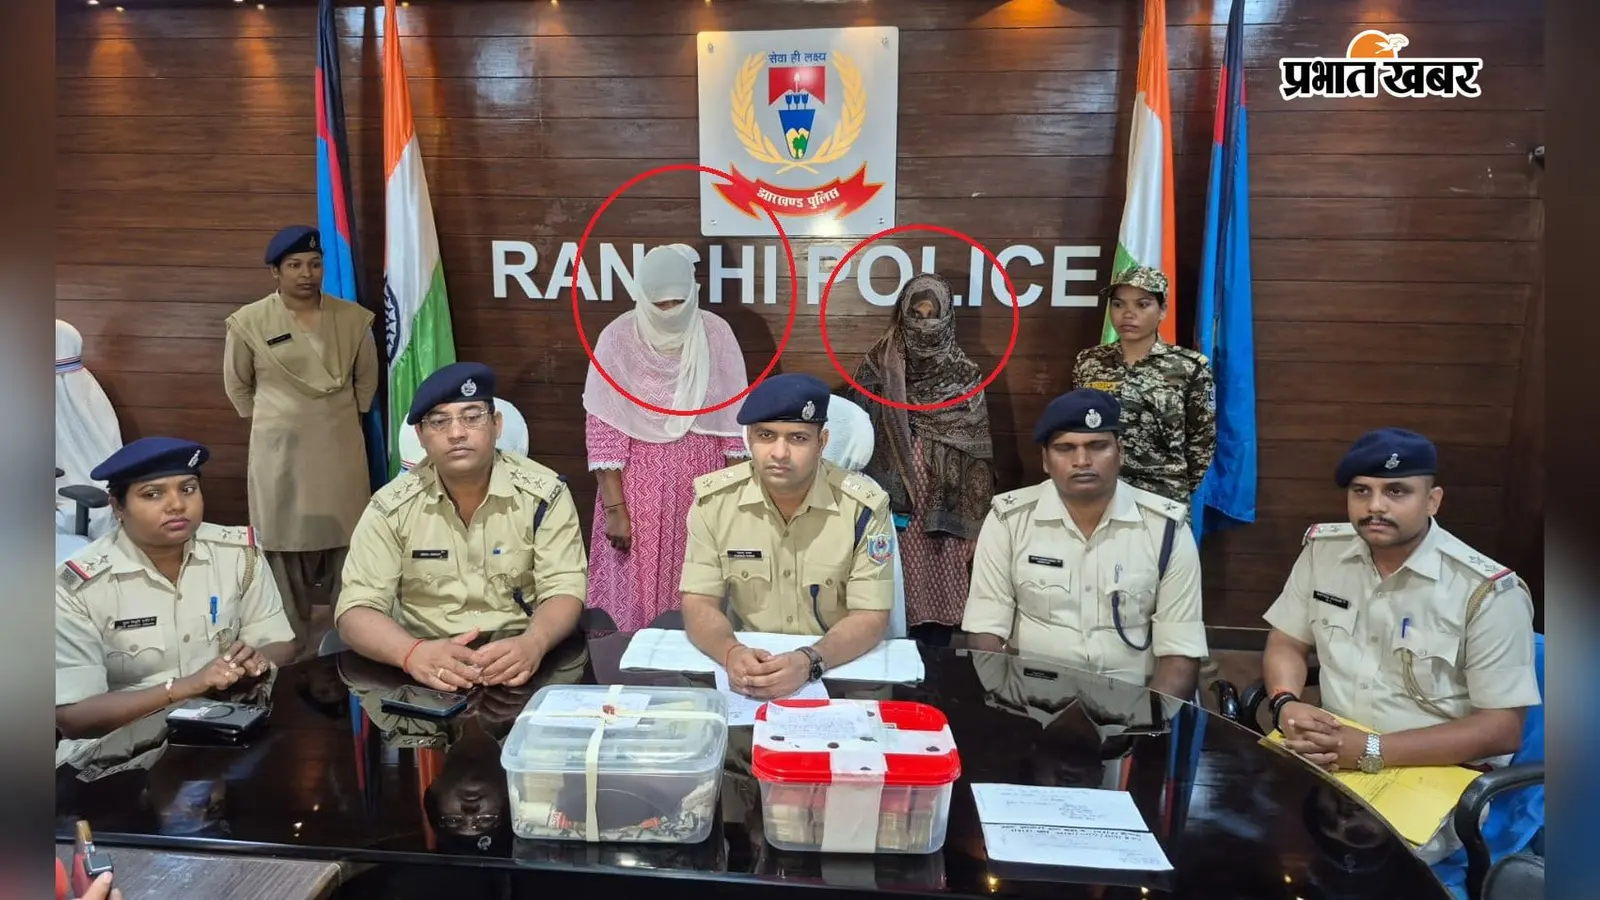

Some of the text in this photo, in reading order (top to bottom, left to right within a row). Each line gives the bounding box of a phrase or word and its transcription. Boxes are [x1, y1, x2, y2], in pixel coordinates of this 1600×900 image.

[768, 50, 827, 63] सेवा ही लक्ष्य
[757, 187, 840, 209] झारखण्ड पुलिस
[491, 240, 777, 304] RANHI
